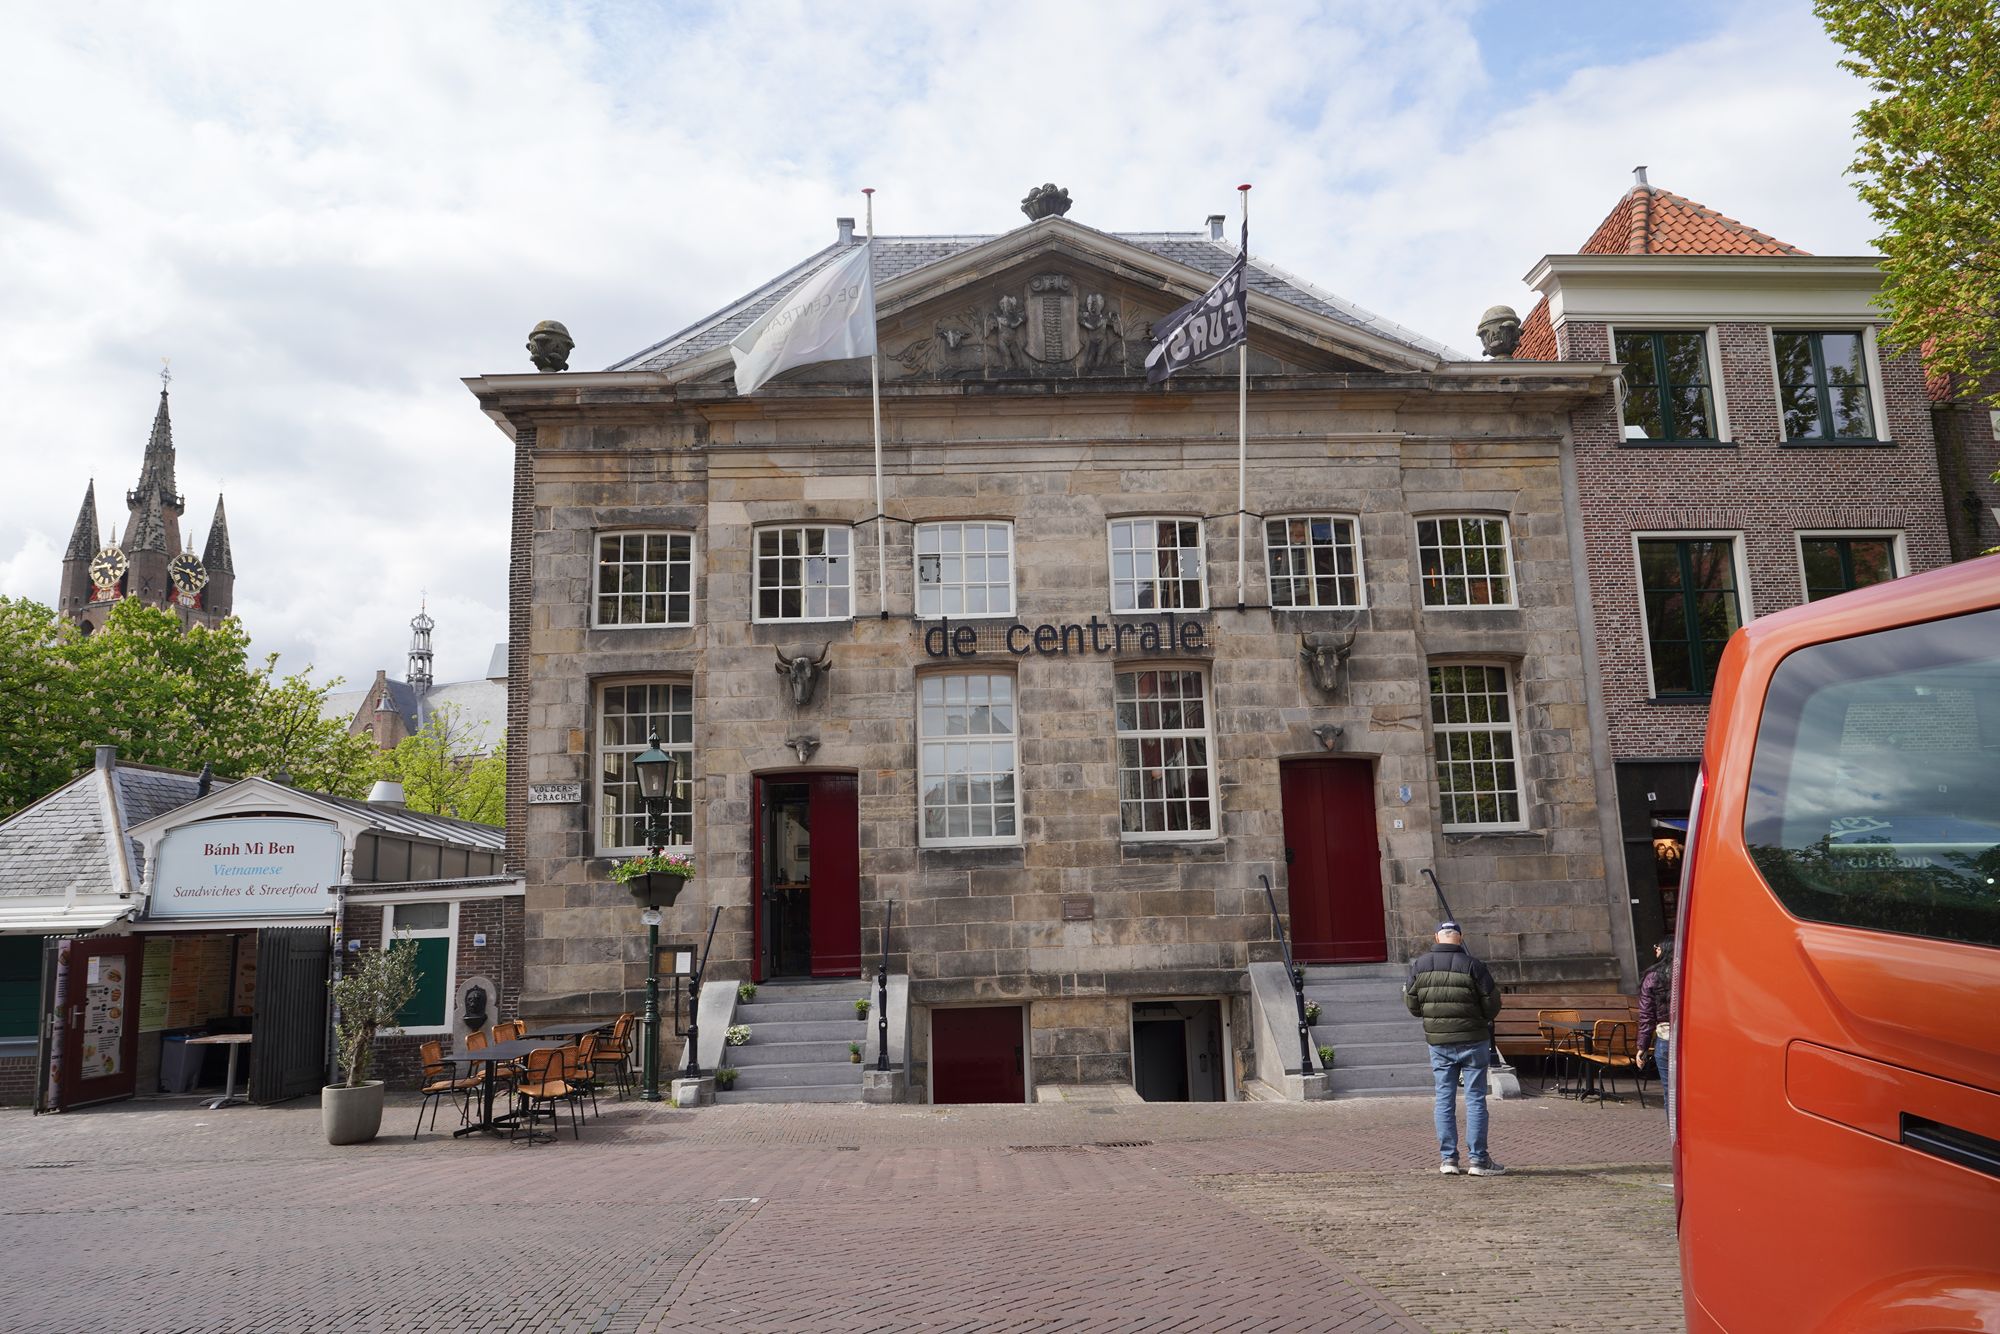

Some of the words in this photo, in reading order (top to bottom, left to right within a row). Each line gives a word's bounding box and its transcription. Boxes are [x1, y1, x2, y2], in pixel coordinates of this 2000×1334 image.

[924, 616, 978, 658] de
[1006, 612, 1205, 656] centrale
[536, 793, 573, 801] GRACHT
[204, 843, 240, 856] Bánh
[268, 842, 295, 854] Ben
[213, 864, 283, 876] Vietnamese
[173, 885, 241, 898] Sandwiches
[245, 885, 255, 896] &
[259, 883, 319, 898] Streetfood
